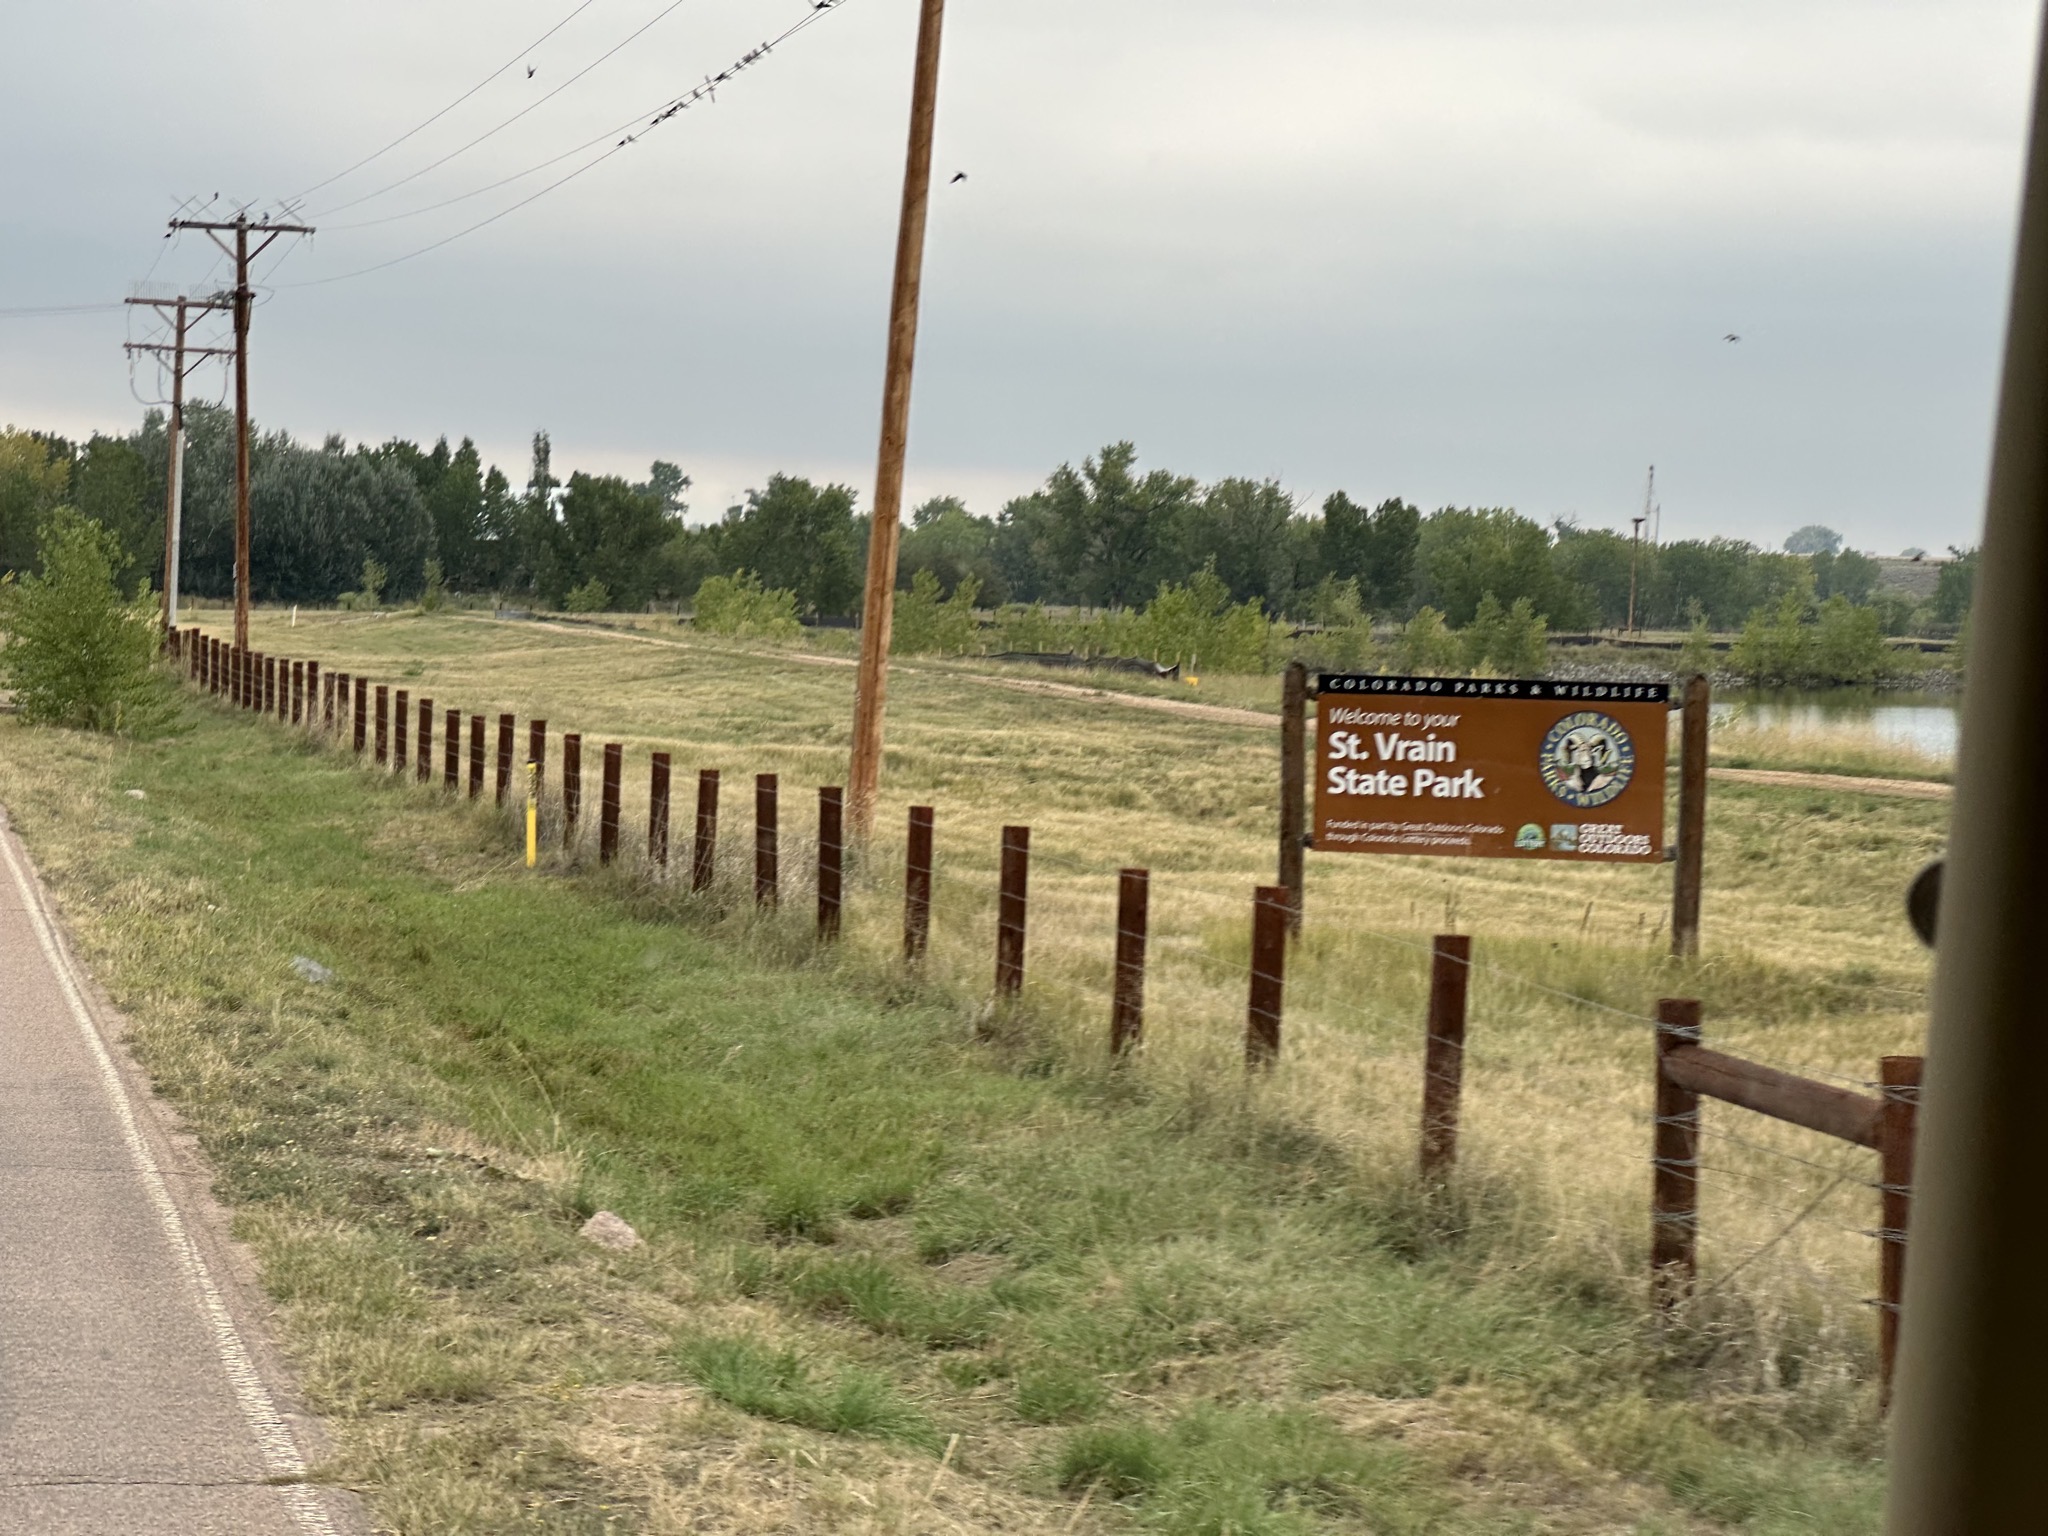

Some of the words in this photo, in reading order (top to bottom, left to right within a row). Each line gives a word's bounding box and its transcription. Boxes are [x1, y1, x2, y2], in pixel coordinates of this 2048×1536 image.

[1329, 678, 1443, 693] COLORADO
[1454, 681, 1519, 695] PARKS
[1529, 683, 1541, 695] &
[1554, 684, 1660, 699] WILDLIFE
[1328, 707, 1402, 727] Welcome
[1403, 711, 1420, 727] to
[1421, 713, 1461, 731] your
[1547, 712, 1630, 744] COLORADO
[1328, 731, 1369, 761] St.
[1374, 731, 1456, 763] Vrain
[1327, 766, 1408, 797] State
[1413, 768, 1485, 799] Park
[1578, 833, 1651, 845] OUTDOORS
[1578, 843, 1652, 855] COLORADO
